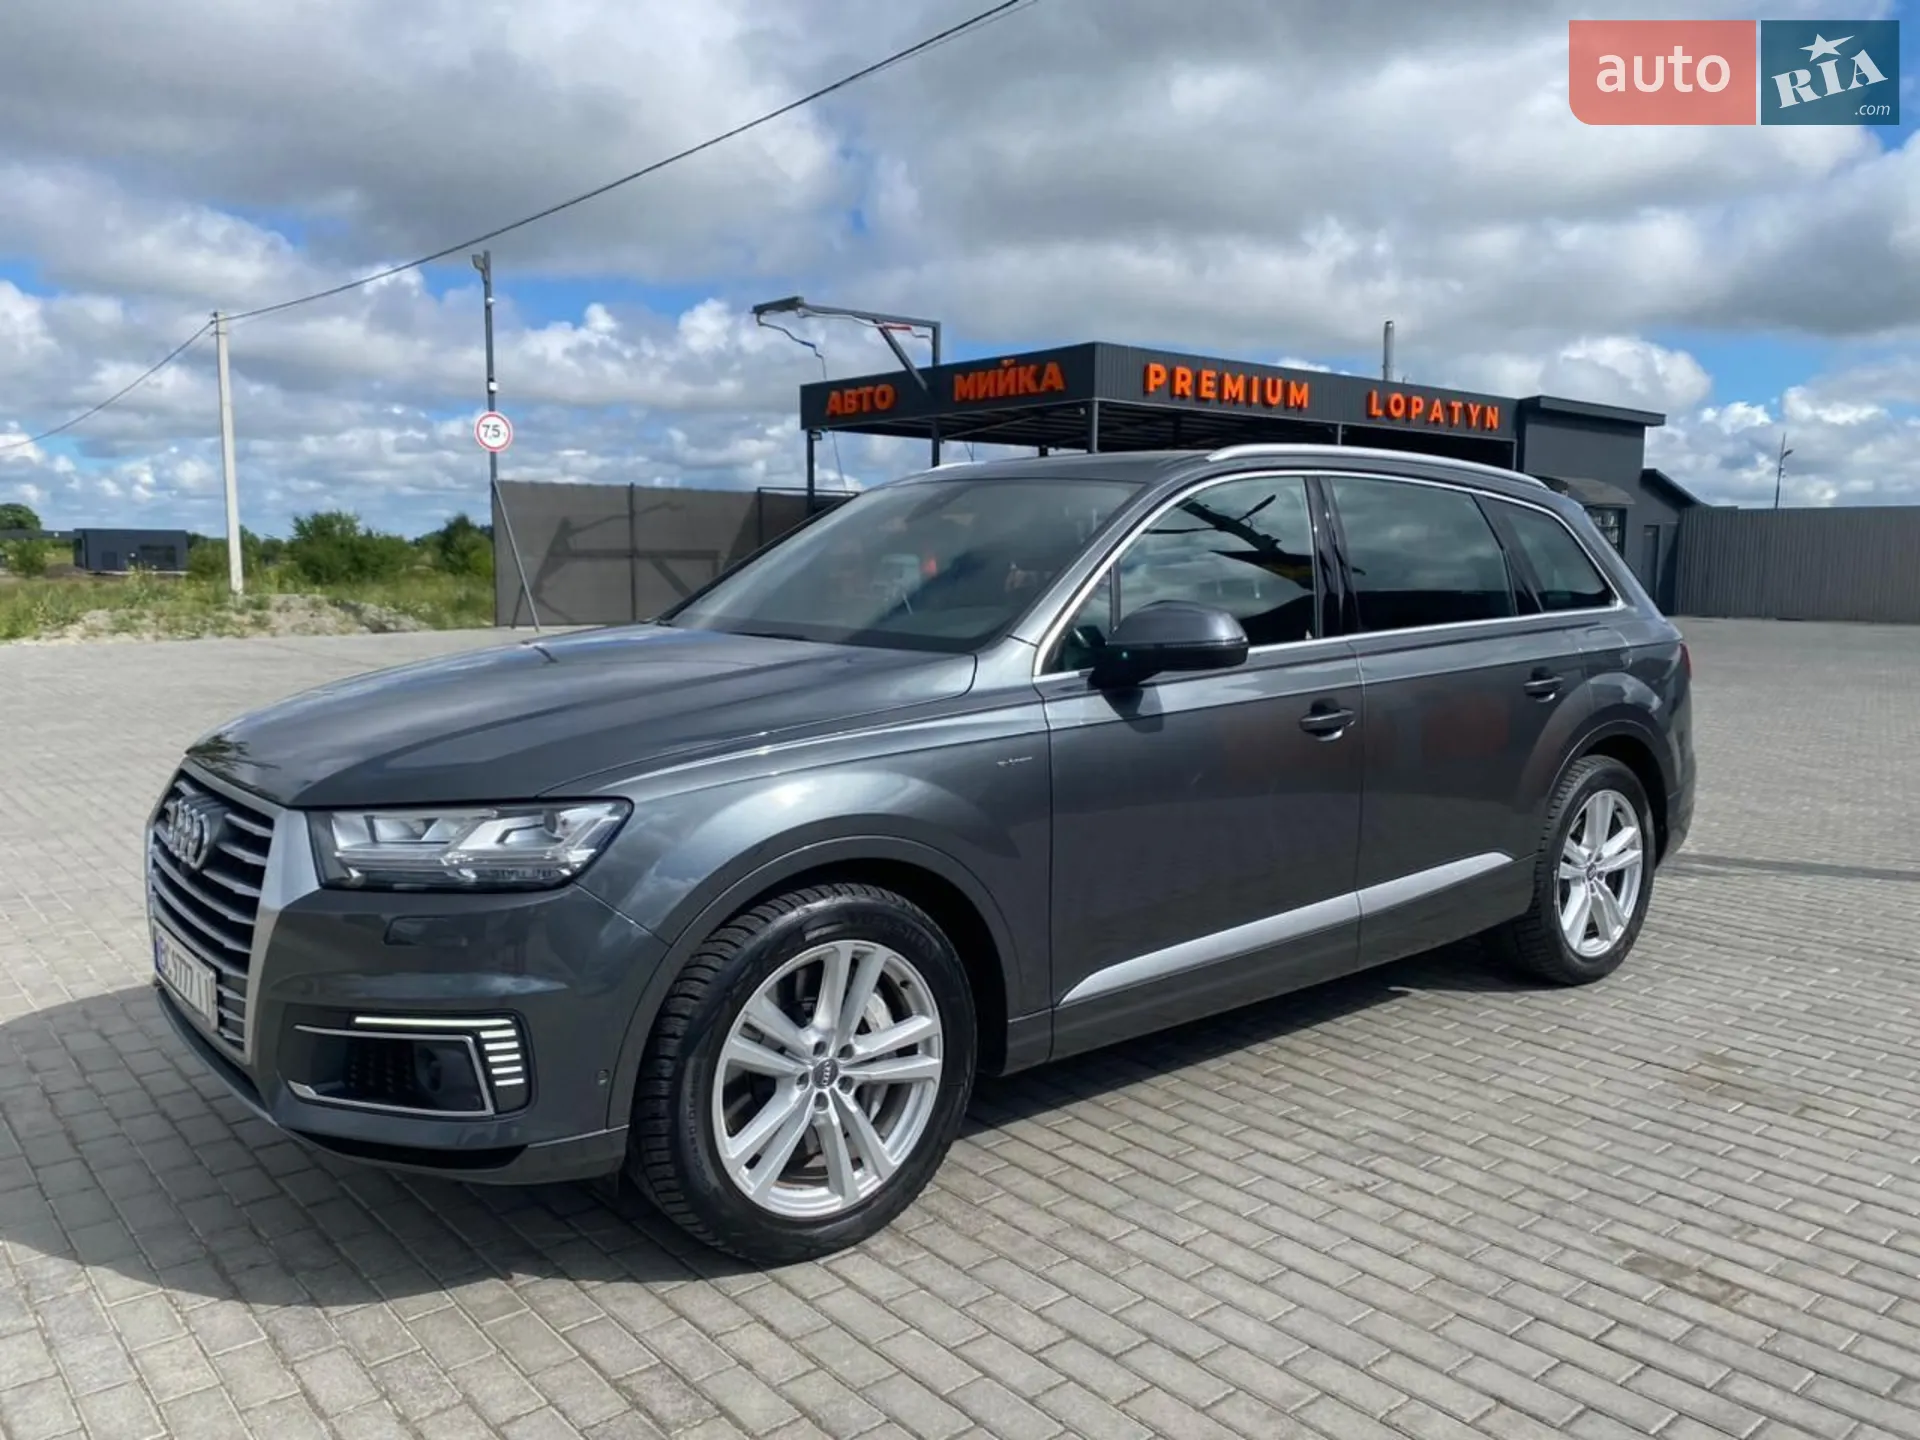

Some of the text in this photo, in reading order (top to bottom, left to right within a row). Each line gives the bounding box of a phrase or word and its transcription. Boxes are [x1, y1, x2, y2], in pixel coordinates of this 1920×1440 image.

[826, 359, 1065, 415] АВТО МИЙКА
[1144, 362, 1500, 430] PREMIUM LOPATYN
